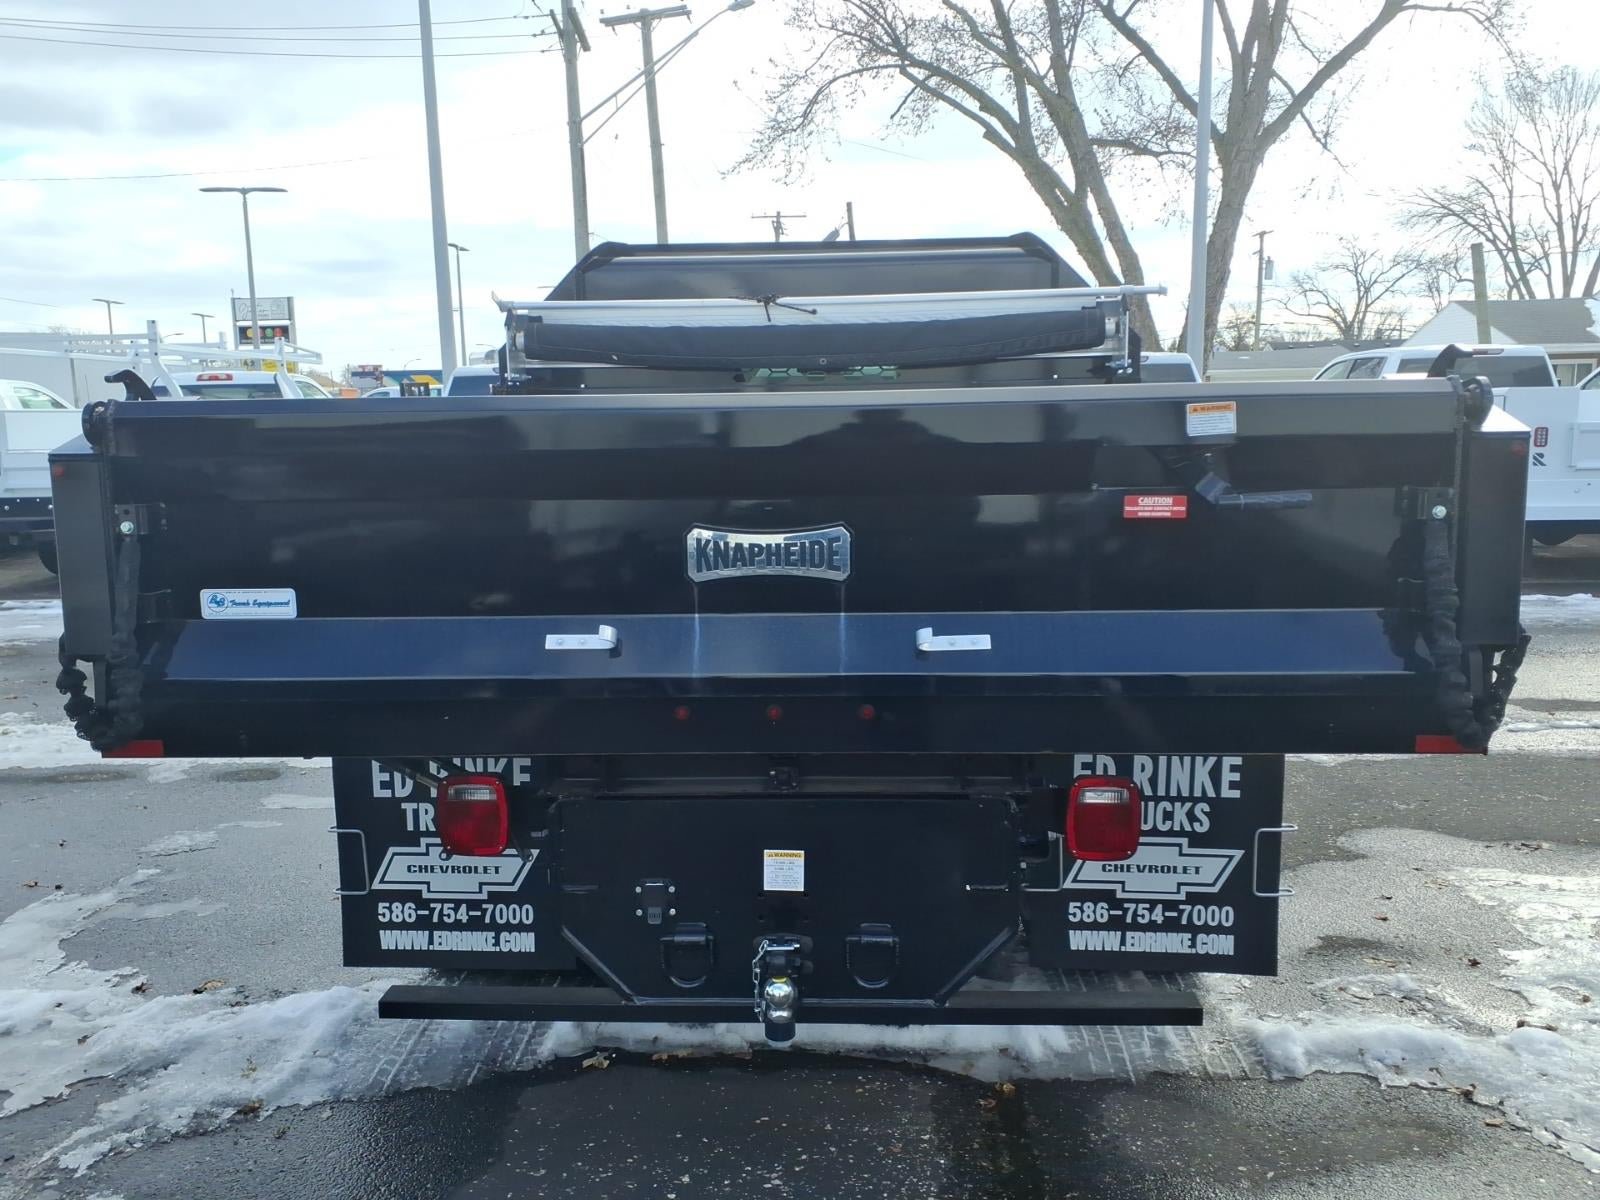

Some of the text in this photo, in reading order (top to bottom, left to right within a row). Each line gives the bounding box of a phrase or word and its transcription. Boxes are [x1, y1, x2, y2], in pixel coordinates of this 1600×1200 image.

[1138, 496, 1173, 505] CAUTION
[695, 537, 842, 573] KNAPHEIDE
[1132, 755, 1243, 798] RINKE
[1141, 801, 1211, 833] UCKS
[406, 864, 502, 875] CHEVROLET
[1101, 863, 1202, 875] CHEVROLET
[377, 902, 534, 924] 586-754-7000
[1068, 902, 1234, 927] 586-754-7000
[379, 929, 535, 952] WWW.EDRINKE.COM
[1068, 929, 1234, 955] WWW.EDRINKE.COM
